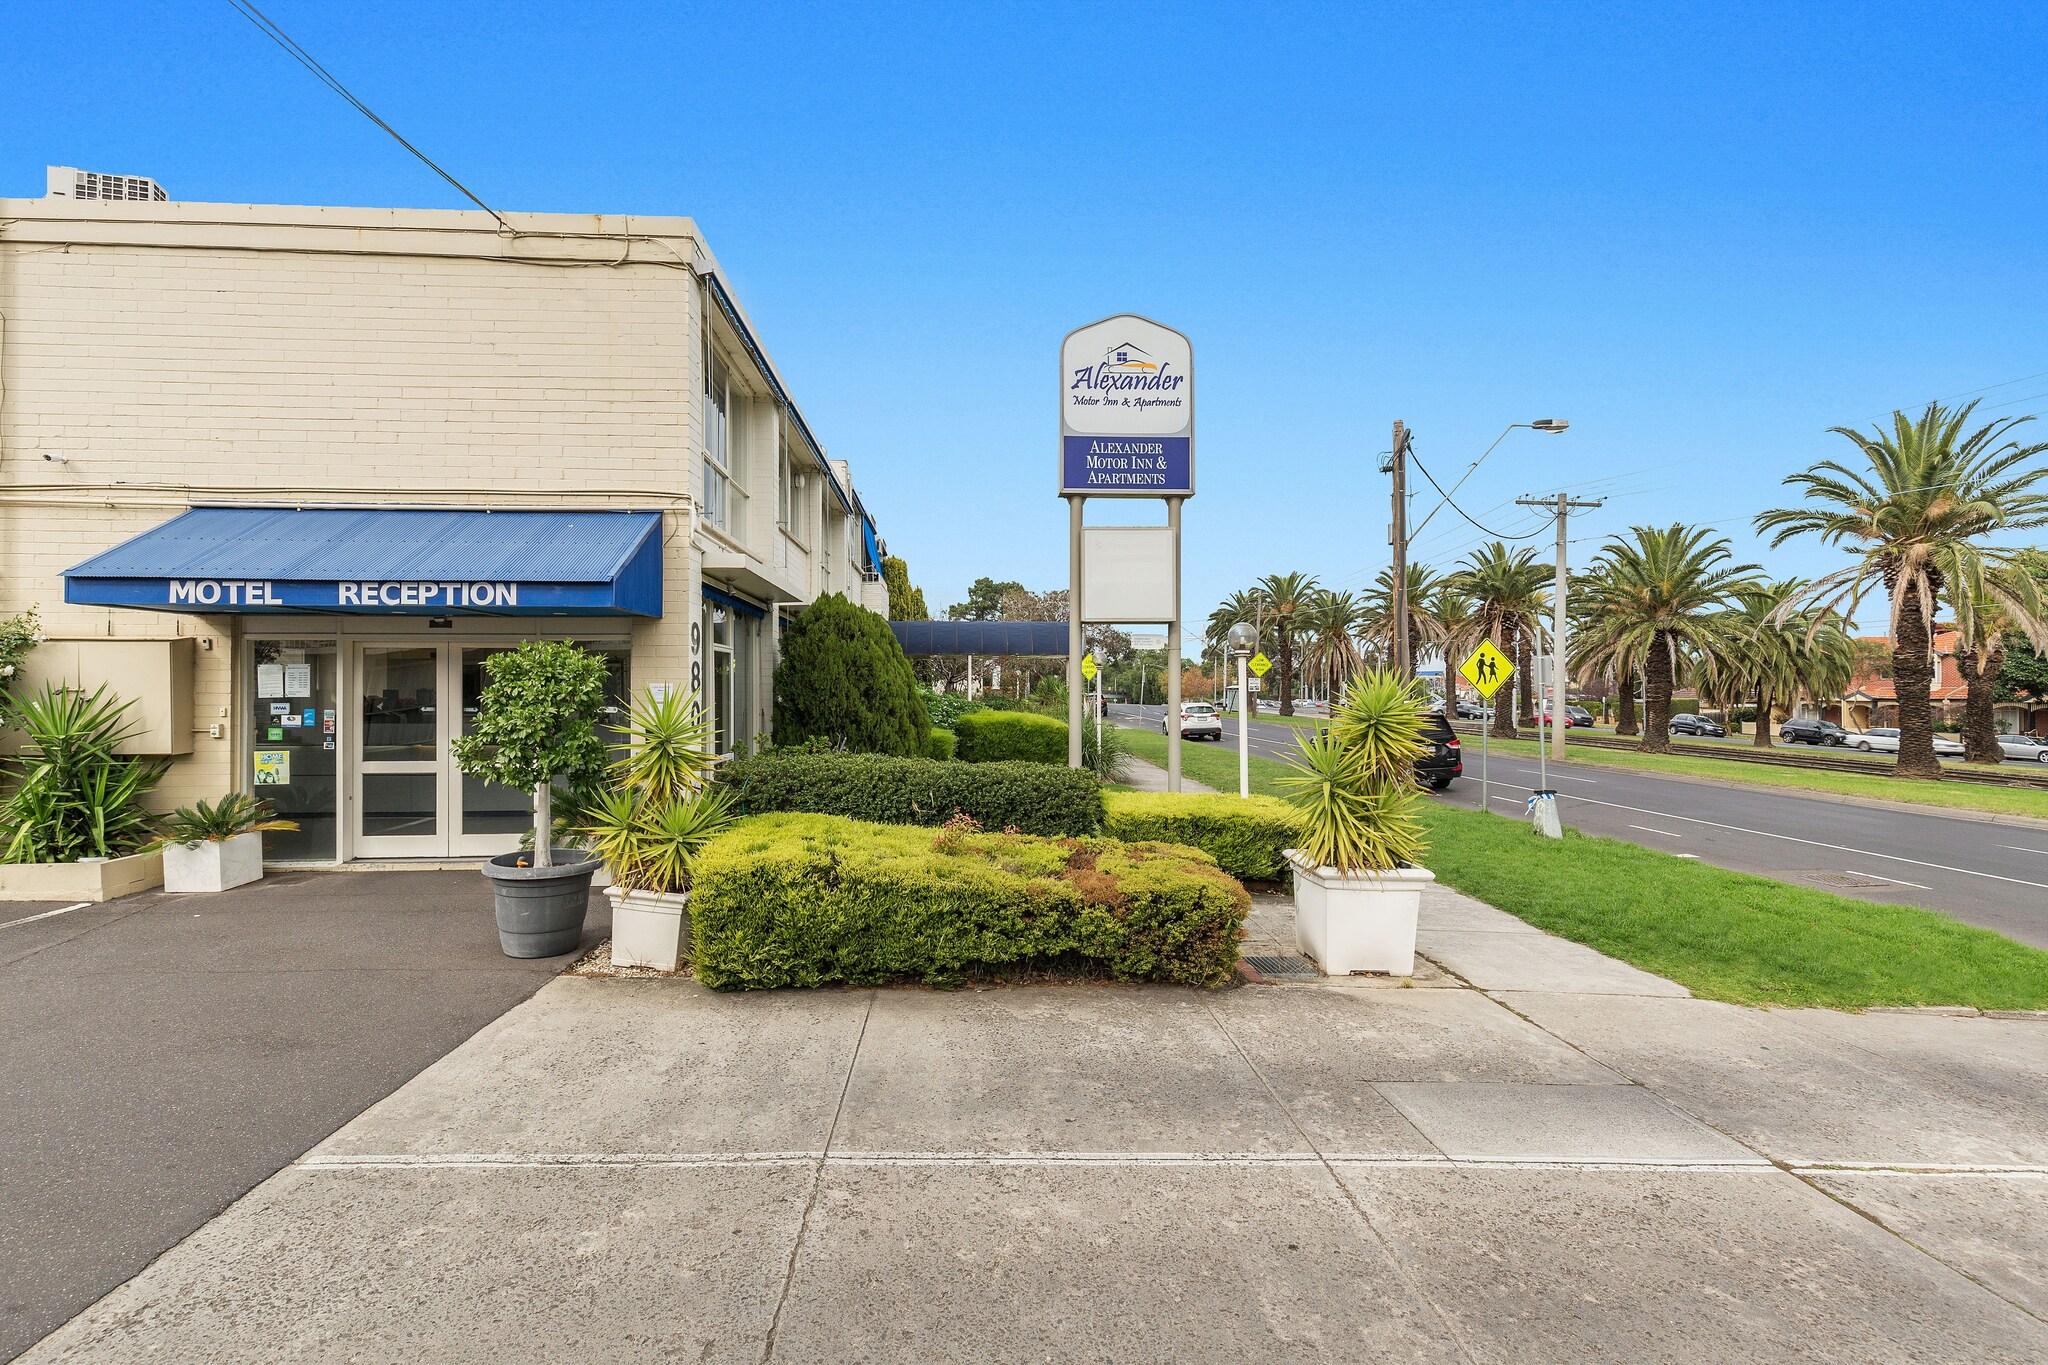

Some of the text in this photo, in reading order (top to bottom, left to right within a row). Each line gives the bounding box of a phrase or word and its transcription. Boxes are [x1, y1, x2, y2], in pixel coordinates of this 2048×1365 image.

[1070, 361, 1184, 396] Alexander
[1073, 395, 1183, 412] Motor Inn & Apartments
[1089, 440, 1163, 454] ALEXANDER
[1086, 455, 1168, 469] MOTOR INN &
[1087, 470, 1166, 485] APARTMENTS
[168, 580, 518, 606] MOTEL RECEPTION
